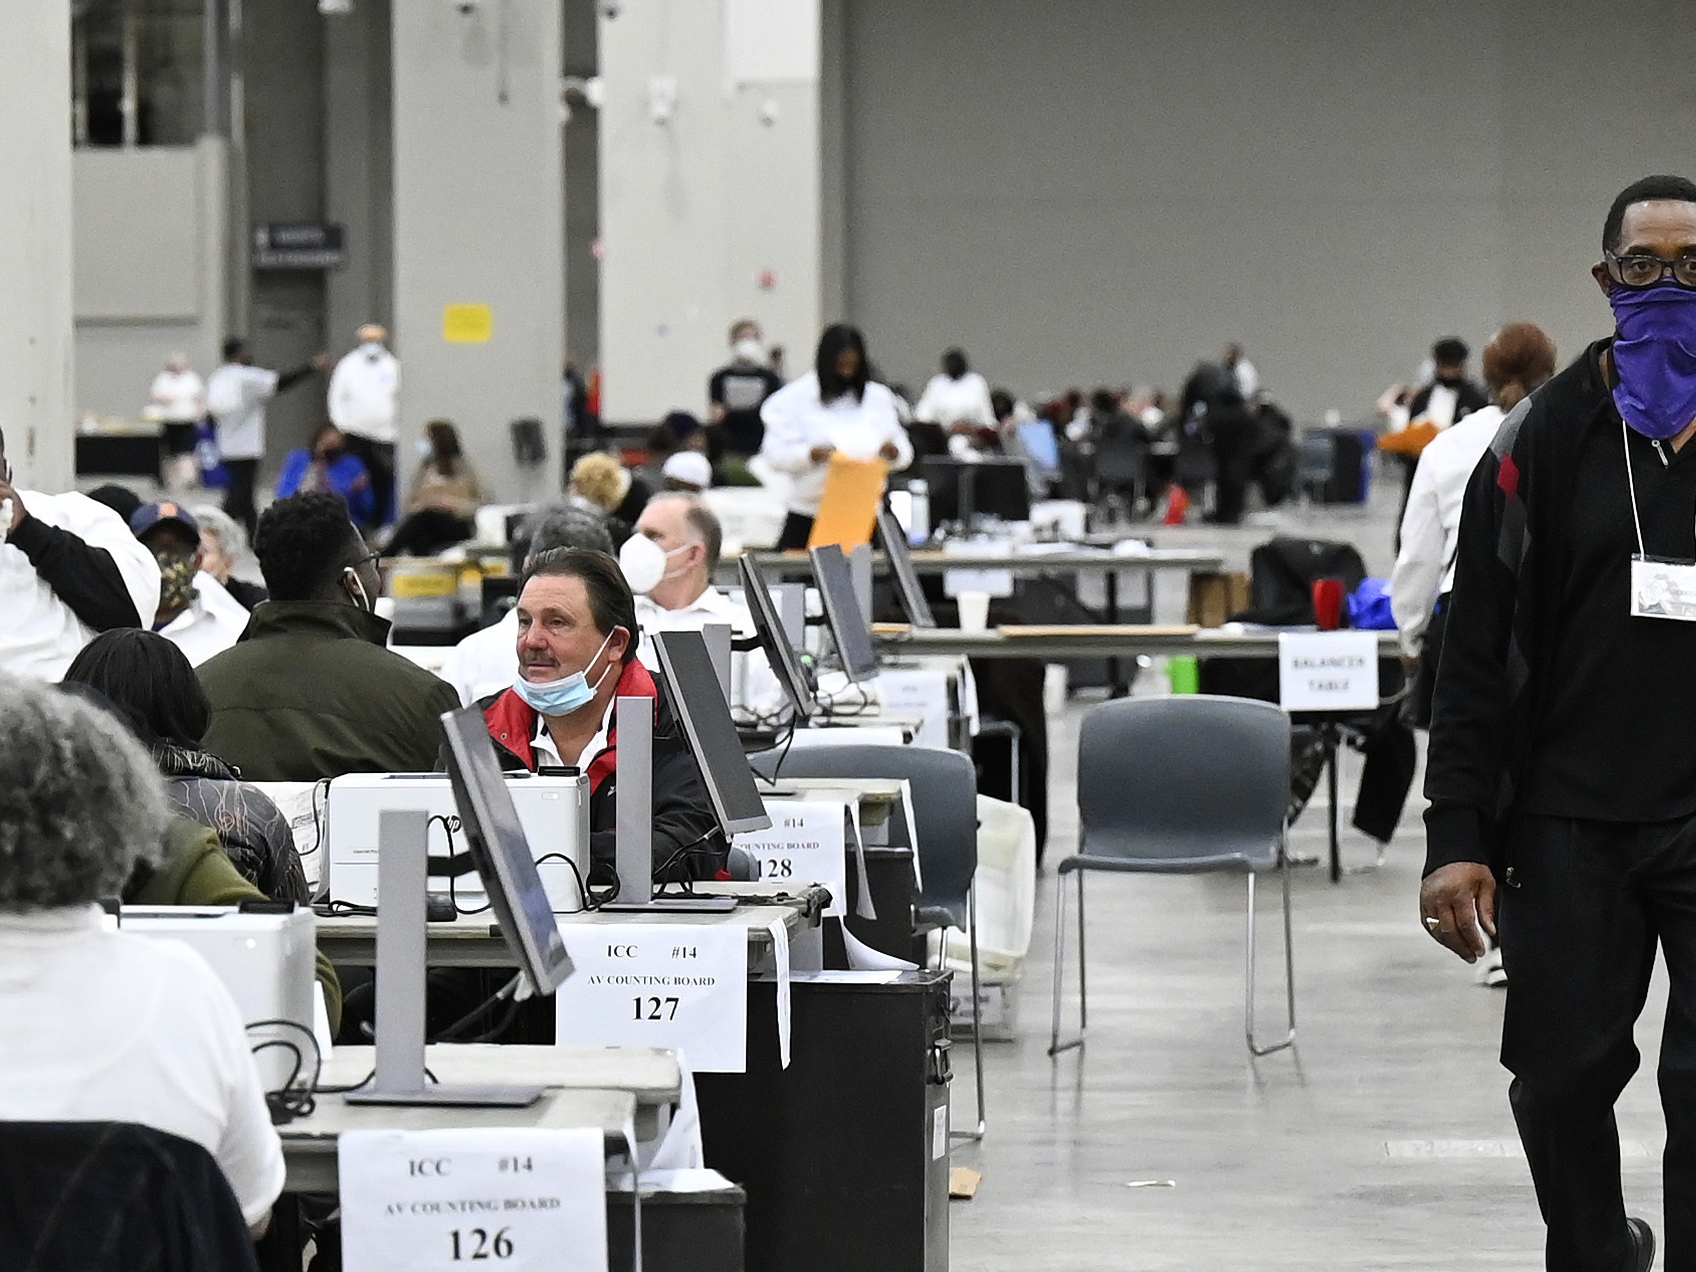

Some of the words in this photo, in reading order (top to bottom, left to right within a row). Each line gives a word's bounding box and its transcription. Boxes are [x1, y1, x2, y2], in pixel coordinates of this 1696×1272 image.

[783, 817, 804, 828] #14
[740, 842, 784, 850] OUNTING
[607, 944, 639, 958] ICC
[671, 946, 698, 959] #14
[587, 975, 605, 985] AV
[607, 976, 671, 986] COUNTING
[674, 977, 715, 986] BOARD
[632, 996, 680, 1021] 127
[407, 1157, 453, 1178] ICC
[498, 1155, 534, 1174] #14
[385, 1201, 404, 1216] AV
[409, 1199, 499, 1215] COUNTING
[503, 1196, 561, 1211] BOARD
[448, 1226, 515, 1261] 126
